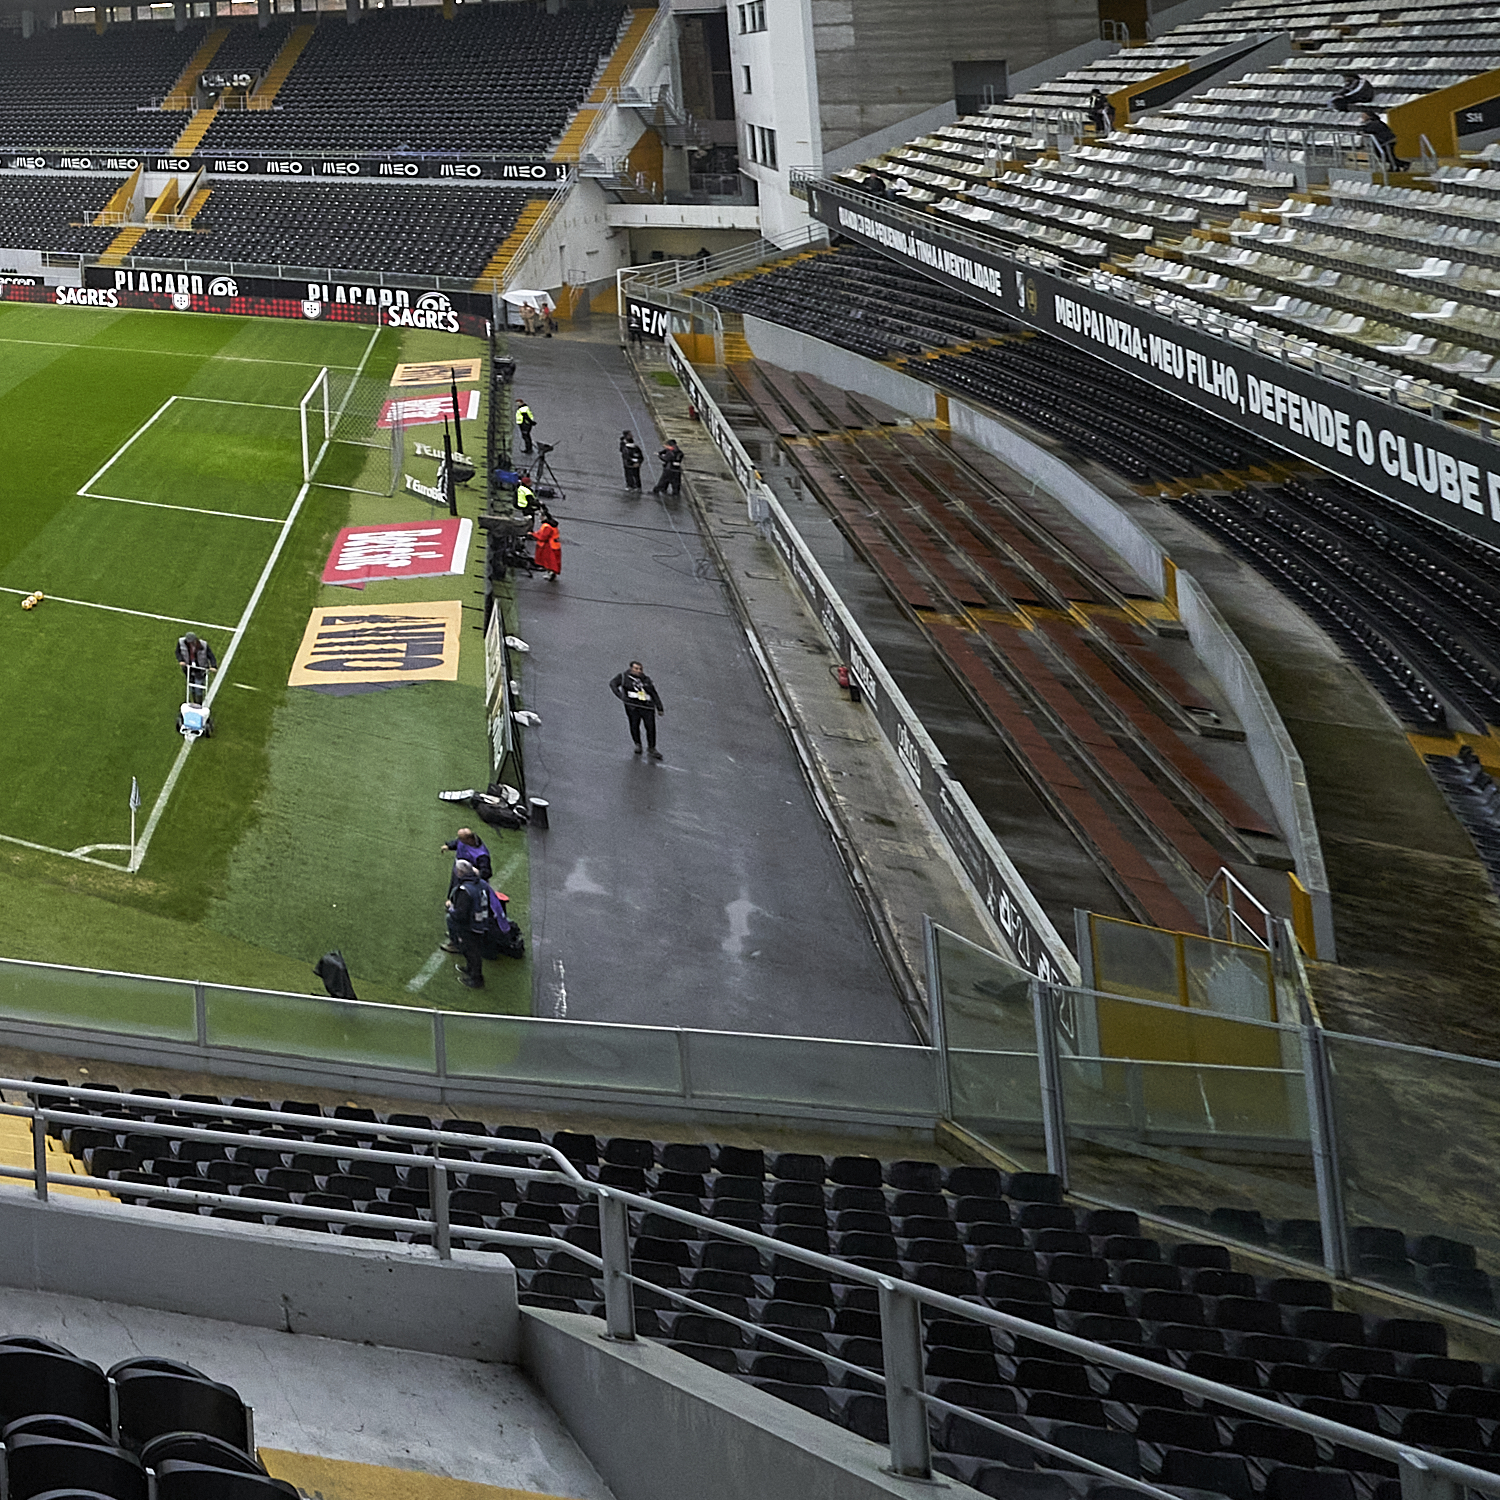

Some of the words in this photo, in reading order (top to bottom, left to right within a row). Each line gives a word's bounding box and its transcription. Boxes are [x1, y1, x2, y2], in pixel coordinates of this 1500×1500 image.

[61, 157, 91, 169] MEO
[107, 158, 138, 169] MEO
[157, 159, 190, 171] MEO
[214, 160, 249, 172] MEO
[266, 161, 303, 174] MEO
[322, 162, 360, 174] MEO
[379, 163, 419, 176] MEO
[440, 164, 481, 177] MEO
[503, 165, 546, 179] MEO
[56, 286, 118, 308] SAGRES
[387, 305, 460, 333] SAGRES
[1054, 294, 1083, 334] MEU
[1083, 307, 1107, 343] PAI
[1106, 315, 1149, 363] DIZIA:
[1148, 333, 1185, 381] MEU
[1185, 347, 1247, 415] FILHO,
[1247, 374, 1354, 458] DEFENDE
[1356, 420, 1376, 467] O
[1379, 428, 1484, 516] CLUBE
